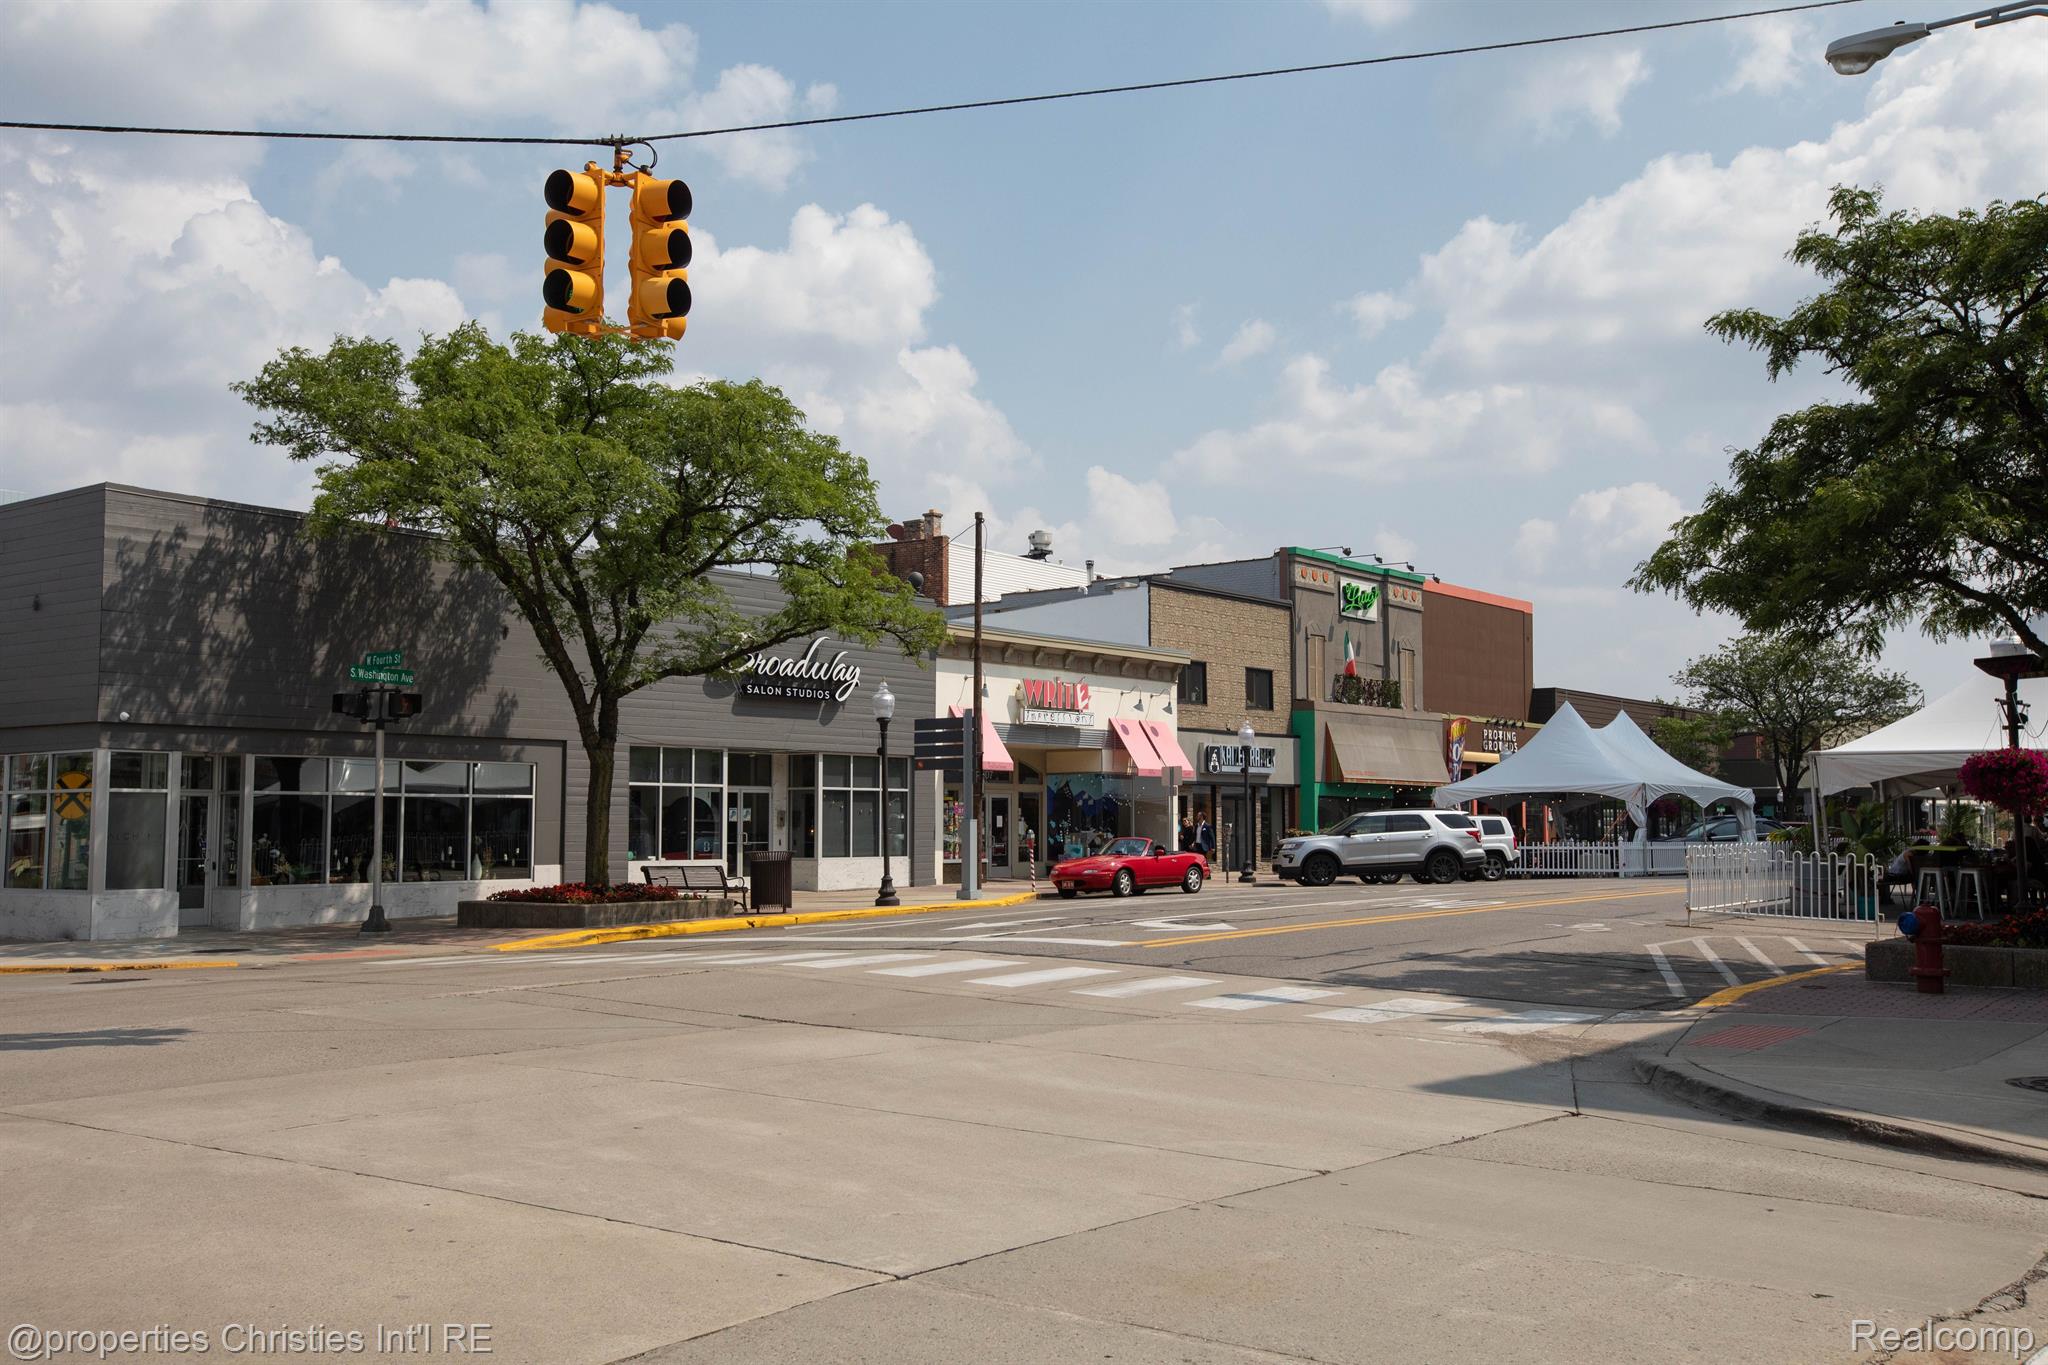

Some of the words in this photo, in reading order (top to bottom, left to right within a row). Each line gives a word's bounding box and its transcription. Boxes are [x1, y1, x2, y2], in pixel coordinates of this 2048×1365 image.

[373, 655, 393, 665] Fourth
[394, 653, 401, 664] St
[358, 668, 399, 682] Washington
[400, 672, 414, 683] Ave
[746, 684, 782, 697] SALON
[786, 688, 831, 700] STUDIOS
